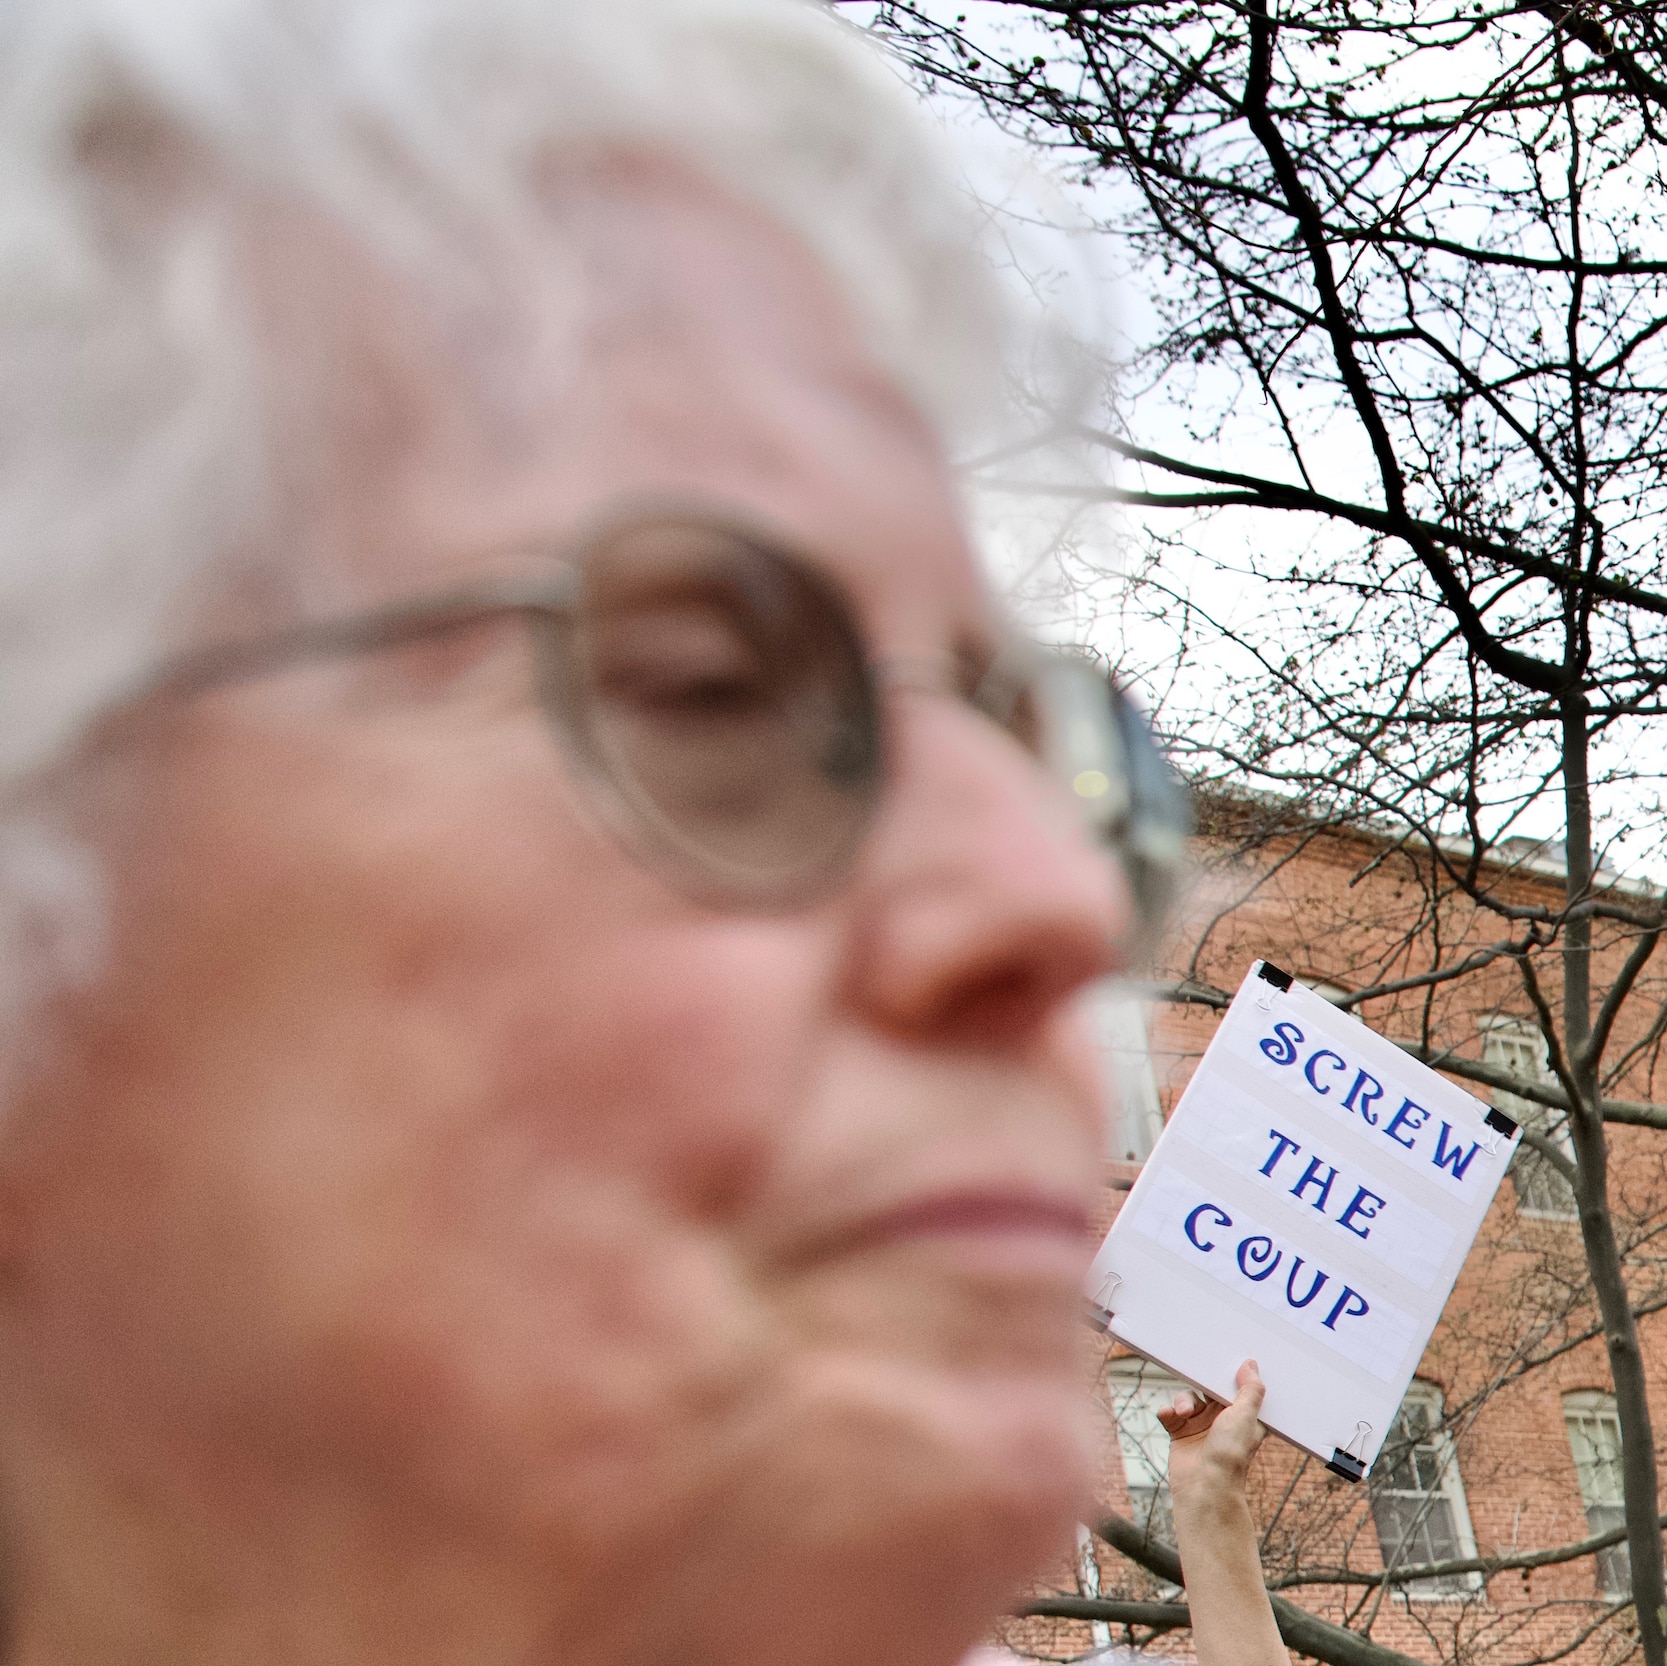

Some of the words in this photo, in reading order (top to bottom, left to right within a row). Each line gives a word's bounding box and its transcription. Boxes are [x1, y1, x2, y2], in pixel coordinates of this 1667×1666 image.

[1258, 1022, 1482, 1182] SCREW
[1258, 1129, 1386, 1239] THE
[1184, 1203, 1369, 1331] COUP
